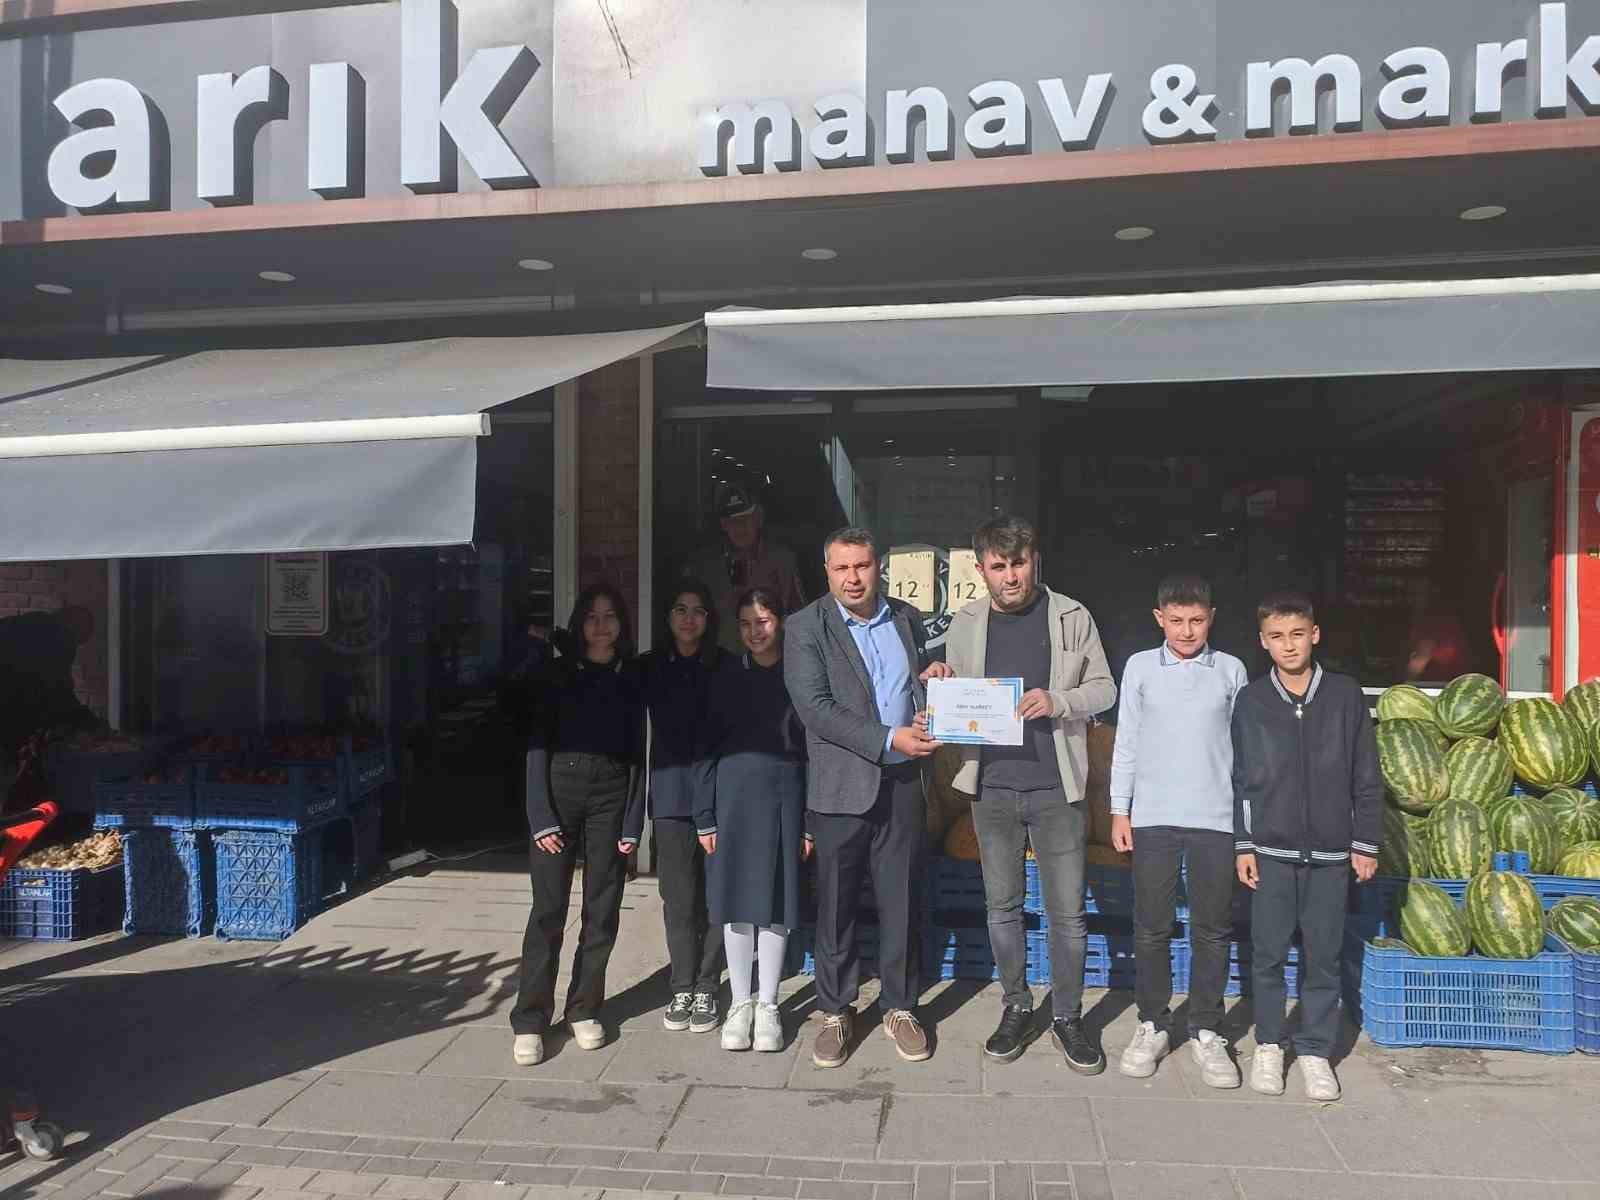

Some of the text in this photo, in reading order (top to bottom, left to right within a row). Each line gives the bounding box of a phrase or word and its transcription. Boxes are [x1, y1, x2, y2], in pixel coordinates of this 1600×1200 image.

[47, 0, 536, 211] arık
[700, 2, 1600, 174] manav & mark
[895, 580, 919, 598] 12
[953, 582, 977, 600] 12
